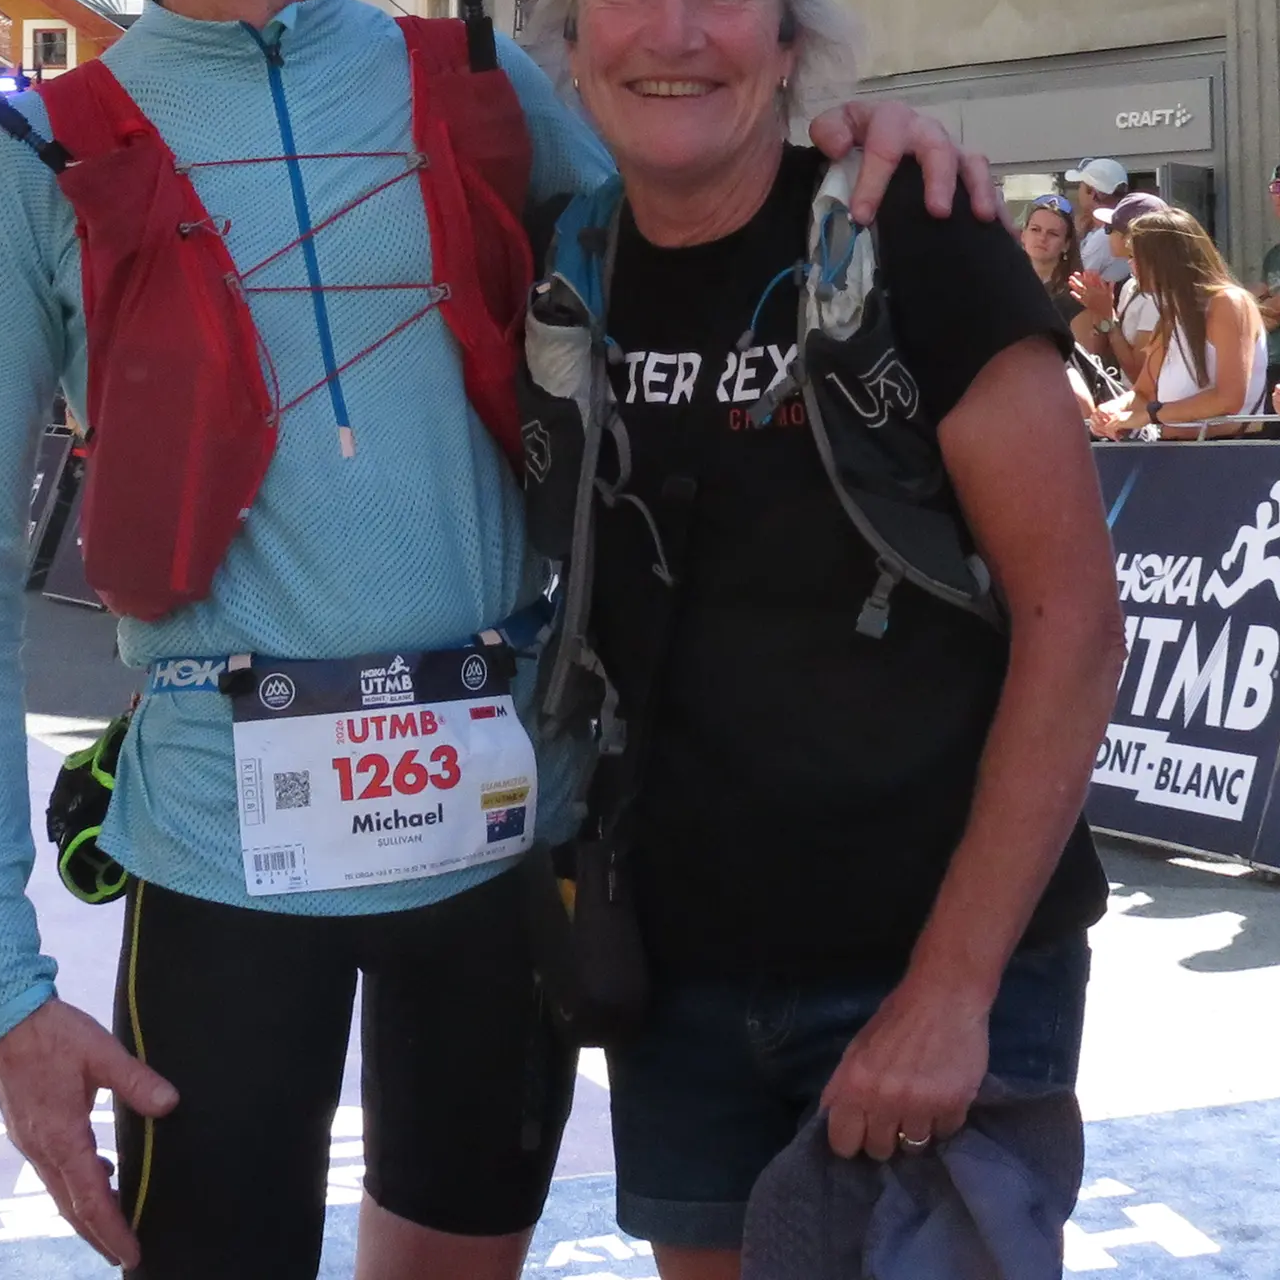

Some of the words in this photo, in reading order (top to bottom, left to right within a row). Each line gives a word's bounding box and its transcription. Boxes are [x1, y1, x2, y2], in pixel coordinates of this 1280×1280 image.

[1115, 109, 1174, 129] CRAFT
[1116, 552, 1203, 606] HOKA
[152, 660, 225, 689] HOK
[361, 675, 413, 694] UTMB
[347, 710, 438, 744] UTMB
[331, 744, 461, 801] 1263
[1093, 737, 1246, 805] ONT-BLANC
[352, 803, 444, 834] Michael
[377, 834, 423, 847] SULLIVAN
